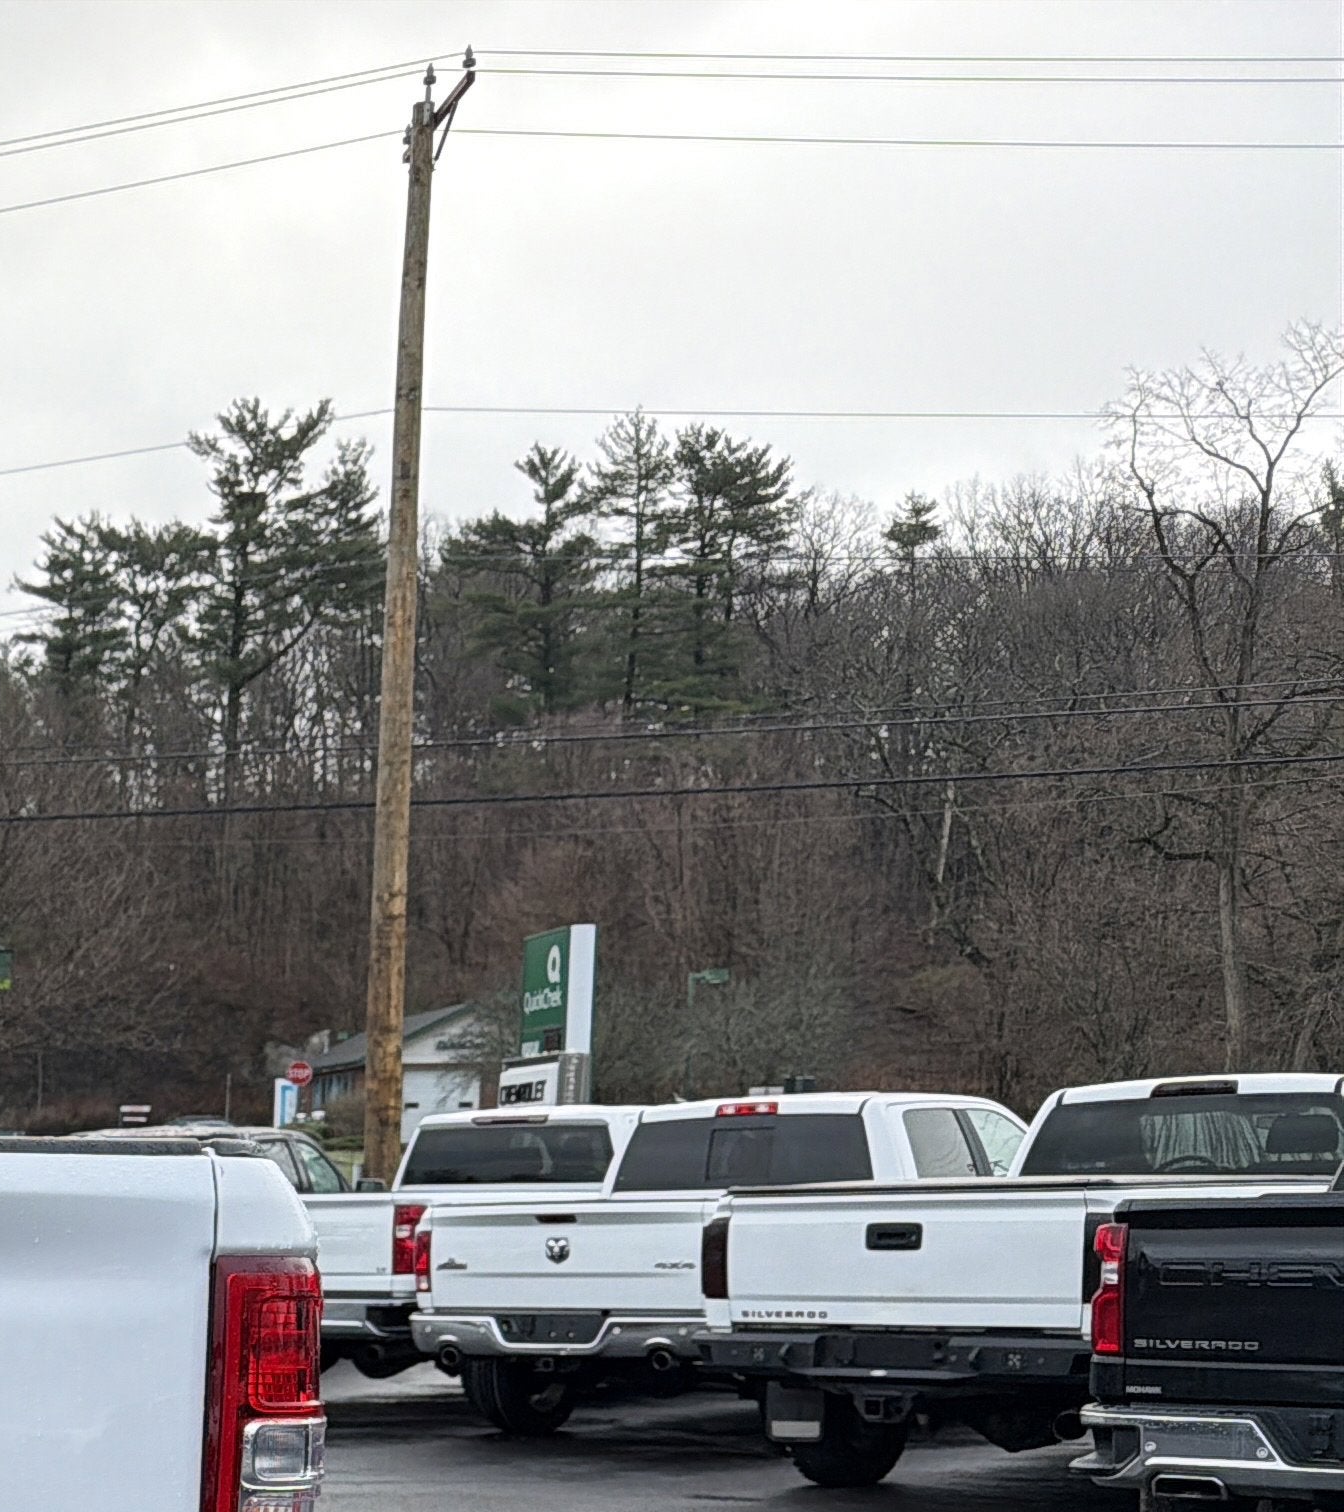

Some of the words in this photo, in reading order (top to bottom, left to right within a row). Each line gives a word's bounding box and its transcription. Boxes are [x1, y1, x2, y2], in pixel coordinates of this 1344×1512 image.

[288, 1068, 311, 1079] STOP
[741, 1310, 828, 1319] SILVERADO
[1133, 1338, 1260, 1351] SILVERADO
